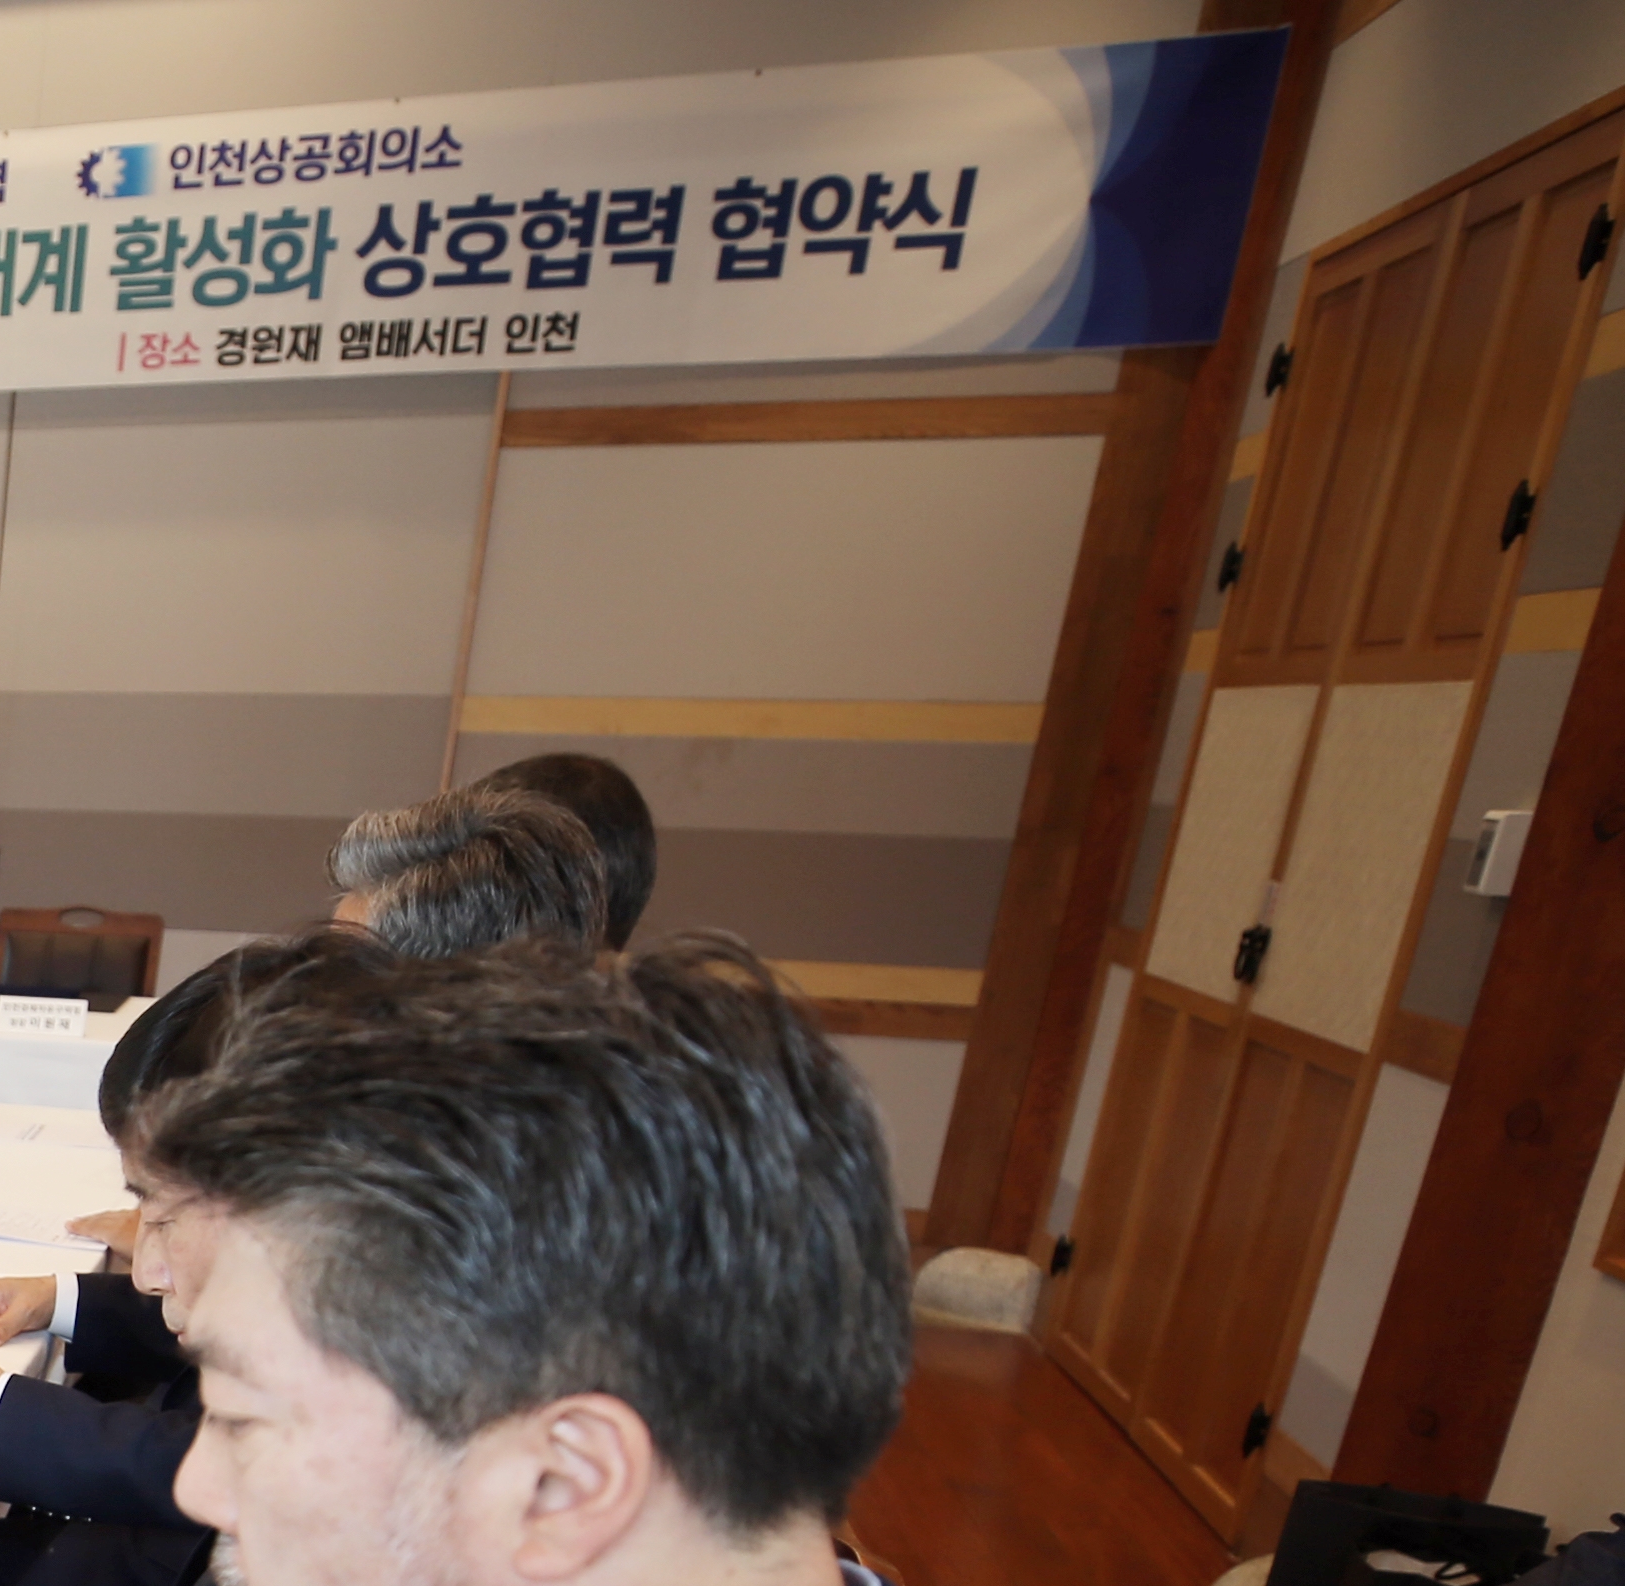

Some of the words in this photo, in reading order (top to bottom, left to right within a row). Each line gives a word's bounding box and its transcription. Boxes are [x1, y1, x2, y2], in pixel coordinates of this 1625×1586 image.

[170, 125, 463, 191] 인천상공회의소
[110, 207, 338, 311] 활성화
[355, 183, 686, 298] 상호협력
[711, 167, 978, 281] 협약식
[139, 333, 200, 370] 장소
[217, 324, 322, 366] 경원재
[340, 316, 488, 360] 앰배서더
[506, 312, 580, 354] 인천
